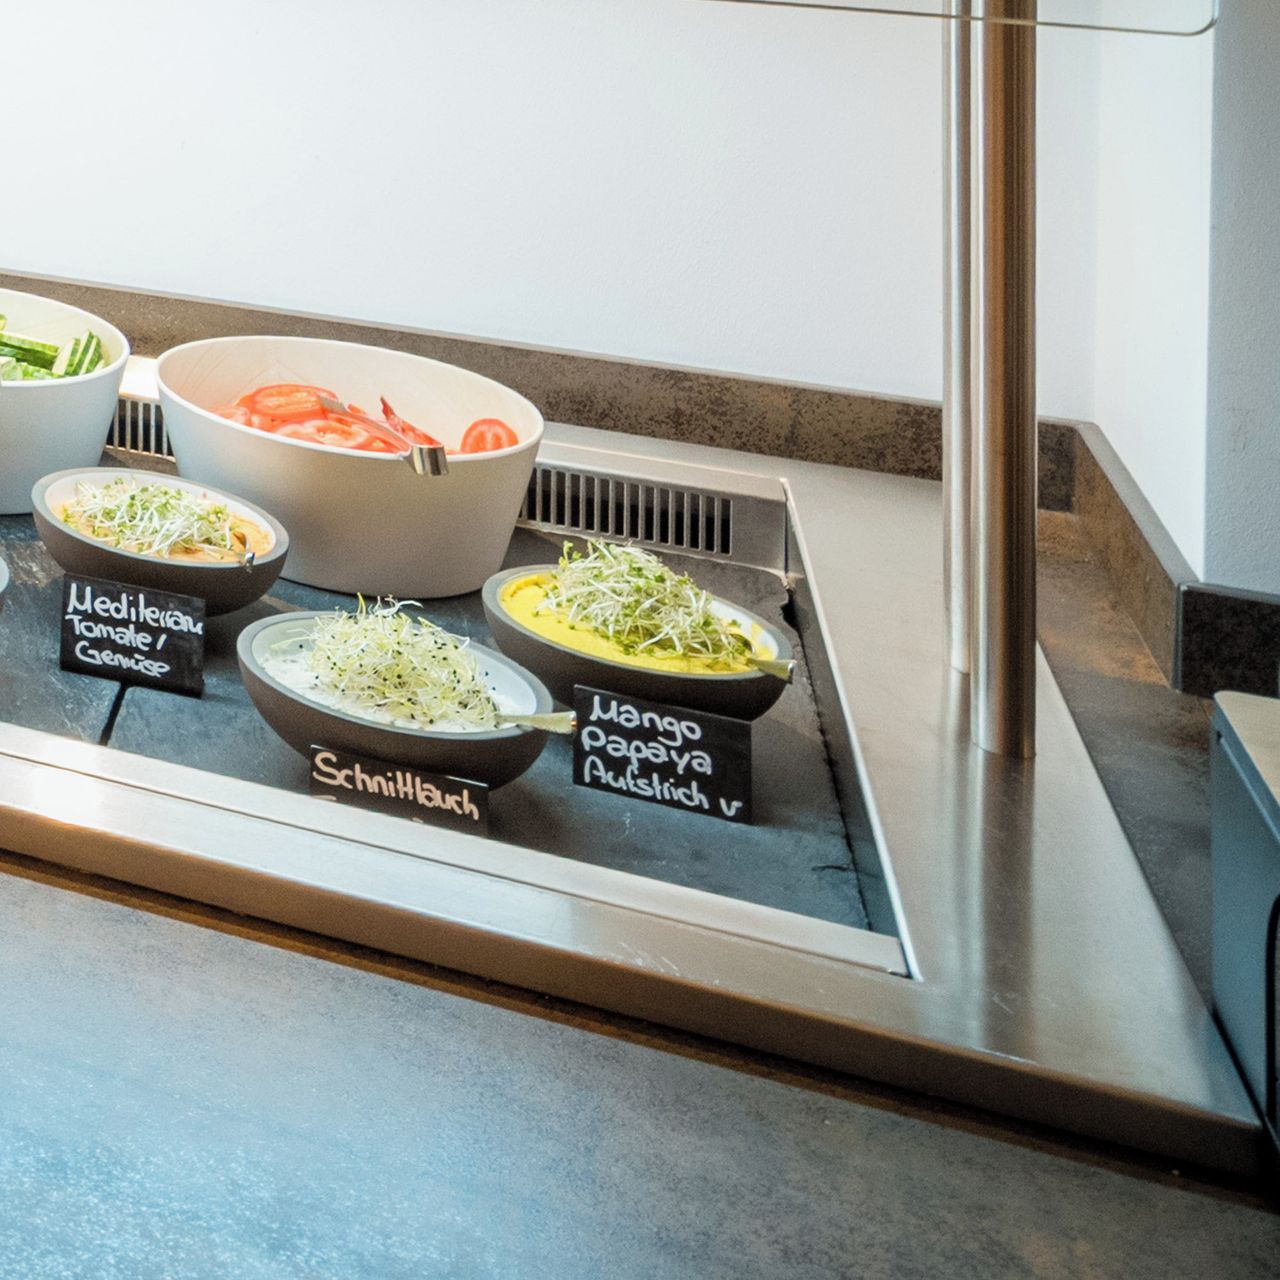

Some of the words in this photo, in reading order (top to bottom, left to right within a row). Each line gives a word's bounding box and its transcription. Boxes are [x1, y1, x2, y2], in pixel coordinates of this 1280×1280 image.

[74, 640, 171, 678] Gemüse
[589, 694, 702, 747] Mango
[581, 725, 712, 776] Papaya
[312, 751, 480, 821] Schnittlauch
